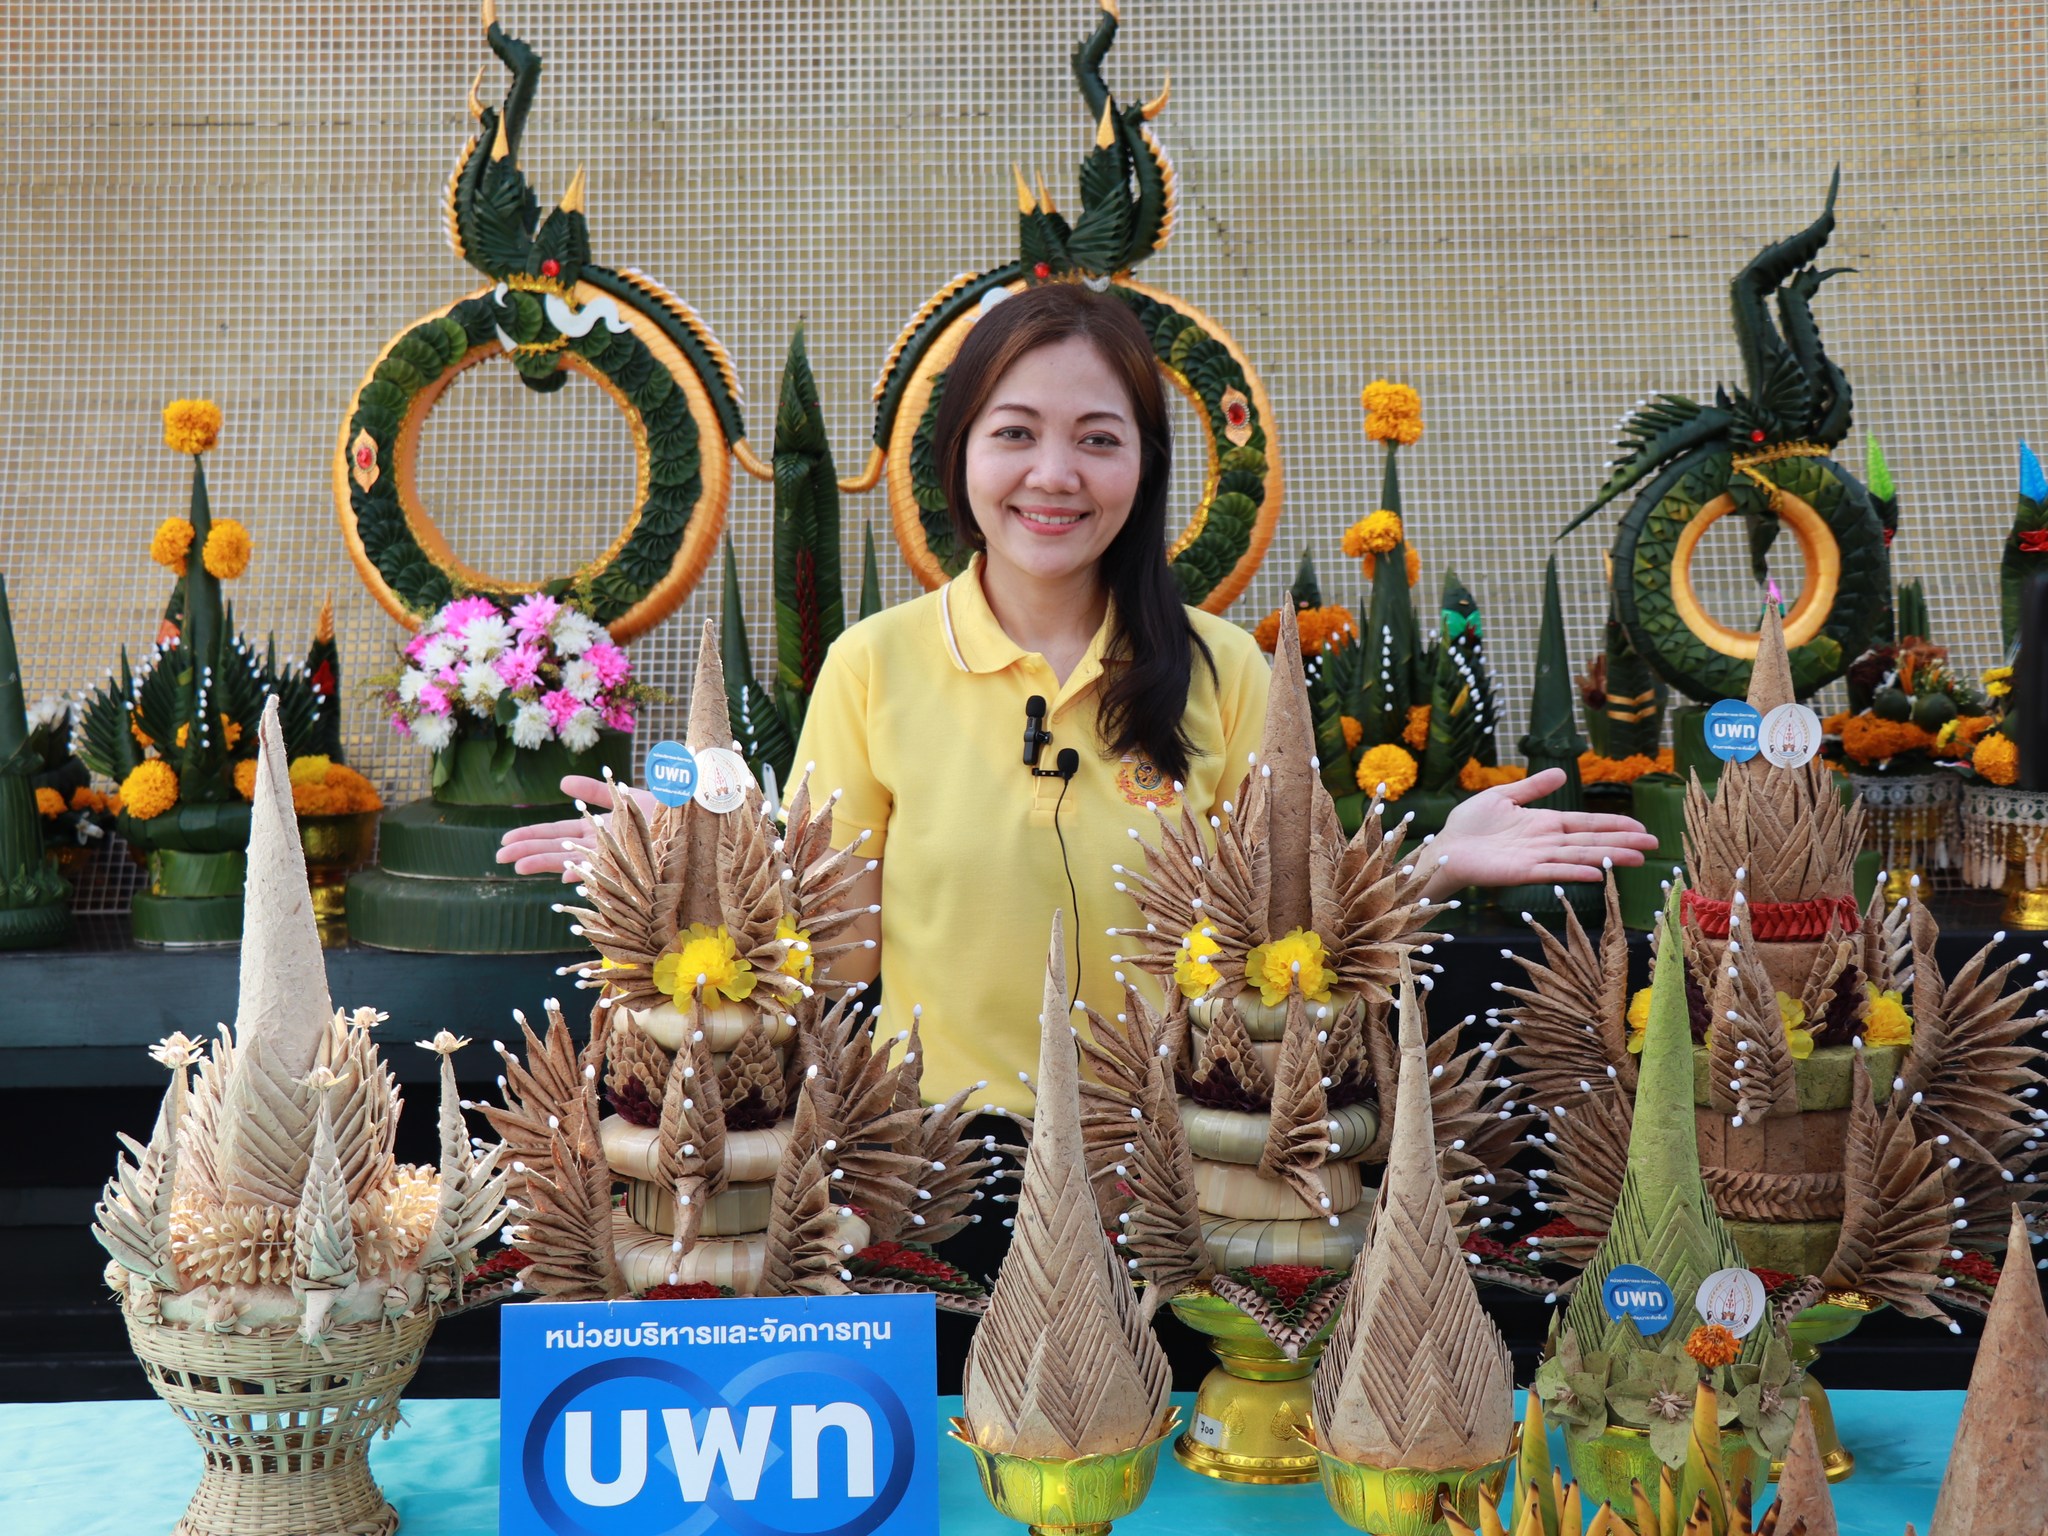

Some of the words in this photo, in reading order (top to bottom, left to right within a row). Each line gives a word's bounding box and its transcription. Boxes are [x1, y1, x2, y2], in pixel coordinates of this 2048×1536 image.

[1714, 723, 1755, 739] บพท
[655, 764, 690, 784] บพท
[1614, 1290, 1663, 1307] บพท
[546, 1318, 891, 1350] หน่วยบริหารและจัดการทุน
[564, 1402, 875, 1507] บพท
